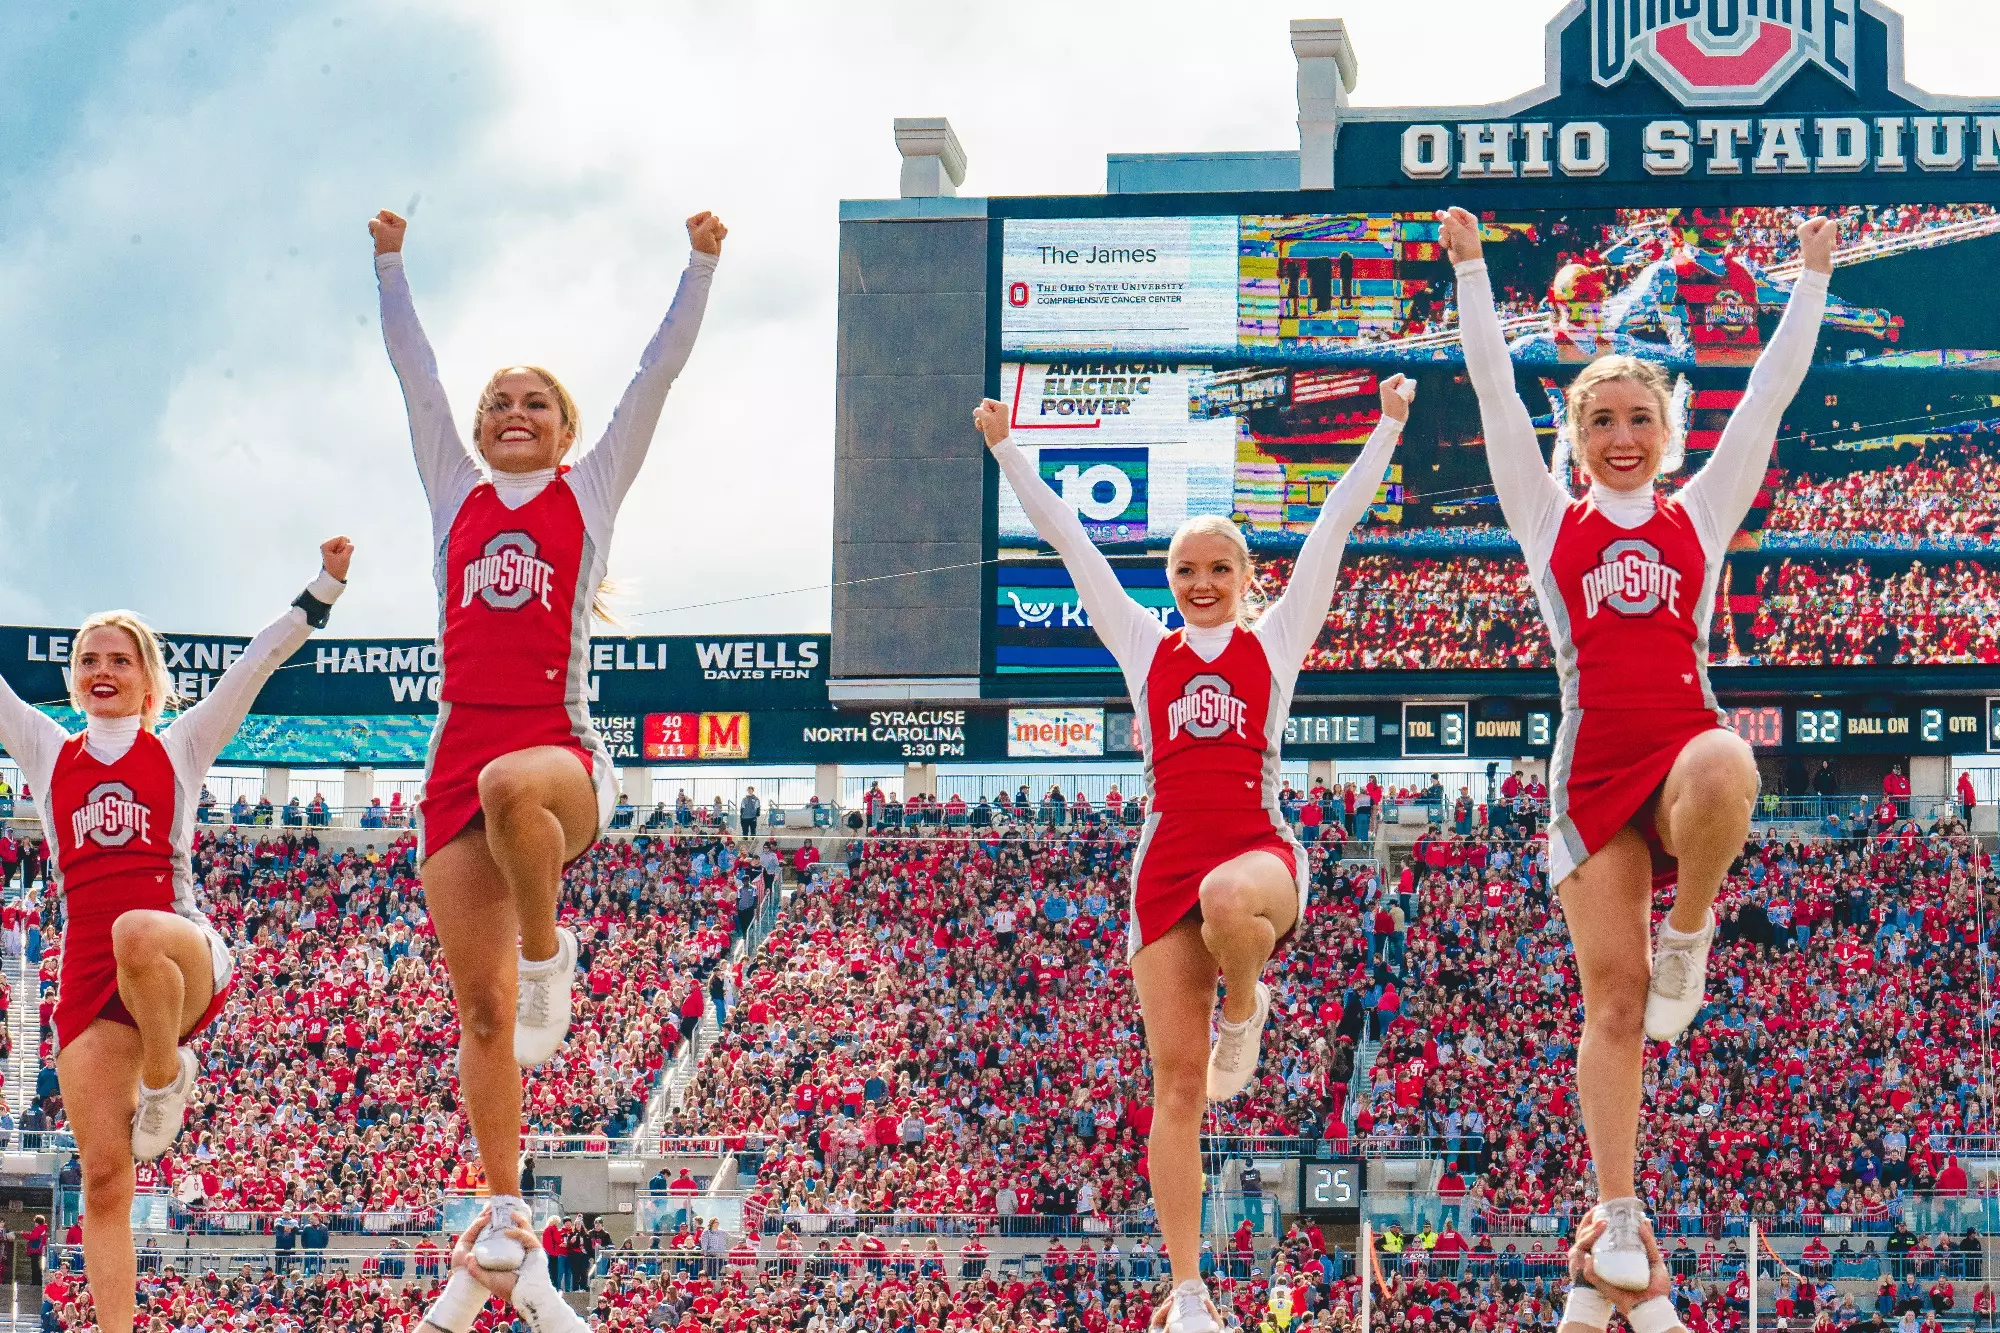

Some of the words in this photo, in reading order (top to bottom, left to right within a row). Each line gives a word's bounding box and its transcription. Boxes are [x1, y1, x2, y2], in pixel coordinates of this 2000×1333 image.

[1401, 122, 1609, 179] OHIO
[1037, 246, 1079, 264] The
[1086, 245, 1157, 264] James
[1037, 297, 1110, 305] COMPREHENSIVE
[1111, 296, 1146, 304] CANCER
[1148, 295, 1182, 303] CENTER
[1043, 377, 1151, 396] ELECTRIC
[1040, 398, 1131, 415] POWER
[1054, 464, 1133, 521] 10
[696, 642, 818, 669] WELLS
[704, 670, 764, 680] DAVIS
[771, 669, 810, 679] FDN
[662, 716, 682, 728] 40
[870, 711, 965, 726] SYRACUSE
[1801, 711, 1839, 742] 32
[1848, 718, 1883, 734] BALL
[1888, 717, 1909, 733] ON
[1923, 710, 1941, 741] 2
[1949, 716, 1977, 733] QTR
[662, 730, 681, 742] 71
[803, 727, 867, 742] NORTH
[872, 726, 965, 742] CAROLINA
[1017, 716, 1094, 747] meijer
[1408, 721, 1435, 737] TOL
[1446, 714, 1462, 745] 3
[1475, 720, 1521, 737] DOWN
[1534, 713, 1549, 744] 3
[657, 744, 685, 757] 111
[902, 743, 935, 757] 3:30
[940, 743, 965, 757] PM
[803, 1088, 812, 1100] 2
[1314, 1169, 1351, 1202] 25
[1020, 1193, 1029, 1206] 7
